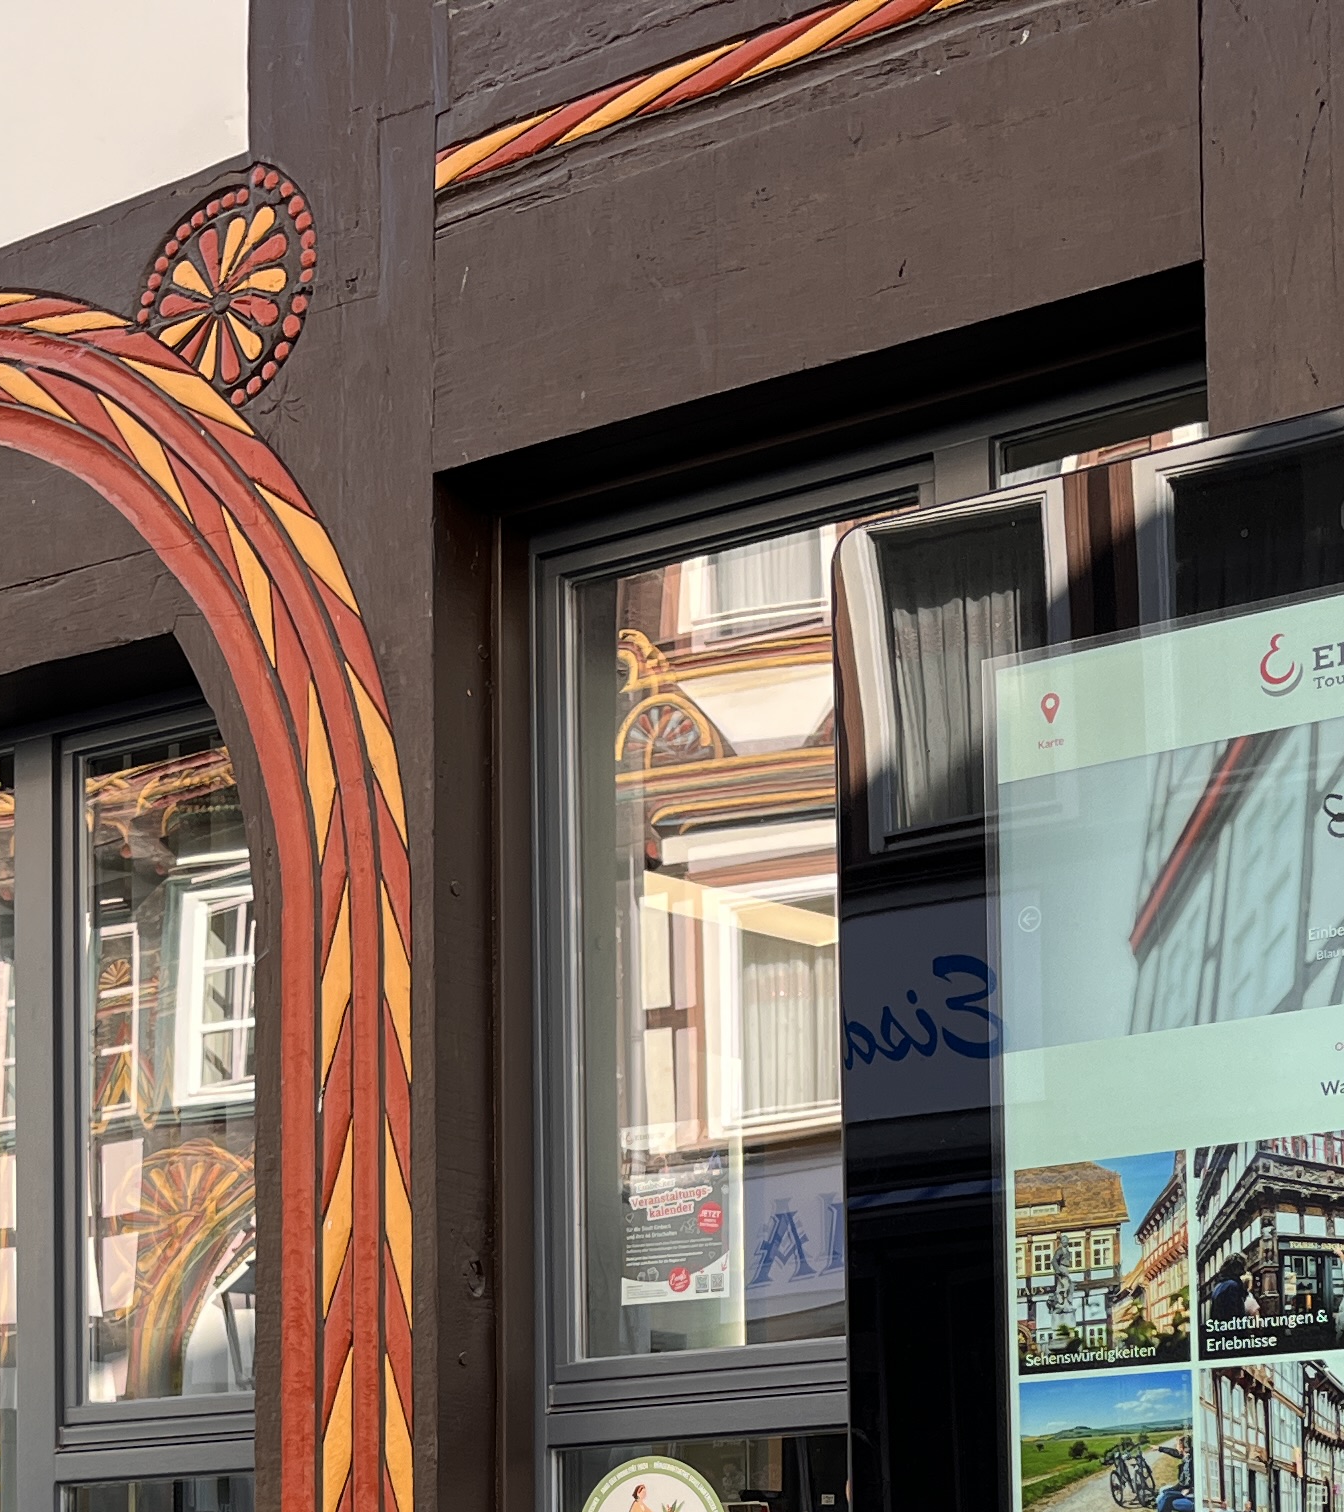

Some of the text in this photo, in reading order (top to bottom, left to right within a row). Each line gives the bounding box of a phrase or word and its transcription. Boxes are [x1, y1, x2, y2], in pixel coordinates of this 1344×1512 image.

[1036, 735, 1066, 752] Karte
[1315, 945, 1341, 961] Blau
[631, 1186, 711, 1208] Veranstaltungs-
[648, 1203, 693, 1219] kalender
[1205, 1309, 1329, 1335] Stadtführungen &
[1205, 1333, 1278, 1352] Erlebnisse
[1025, 1344, 1157, 1368] Sehenswürdigkeiten
